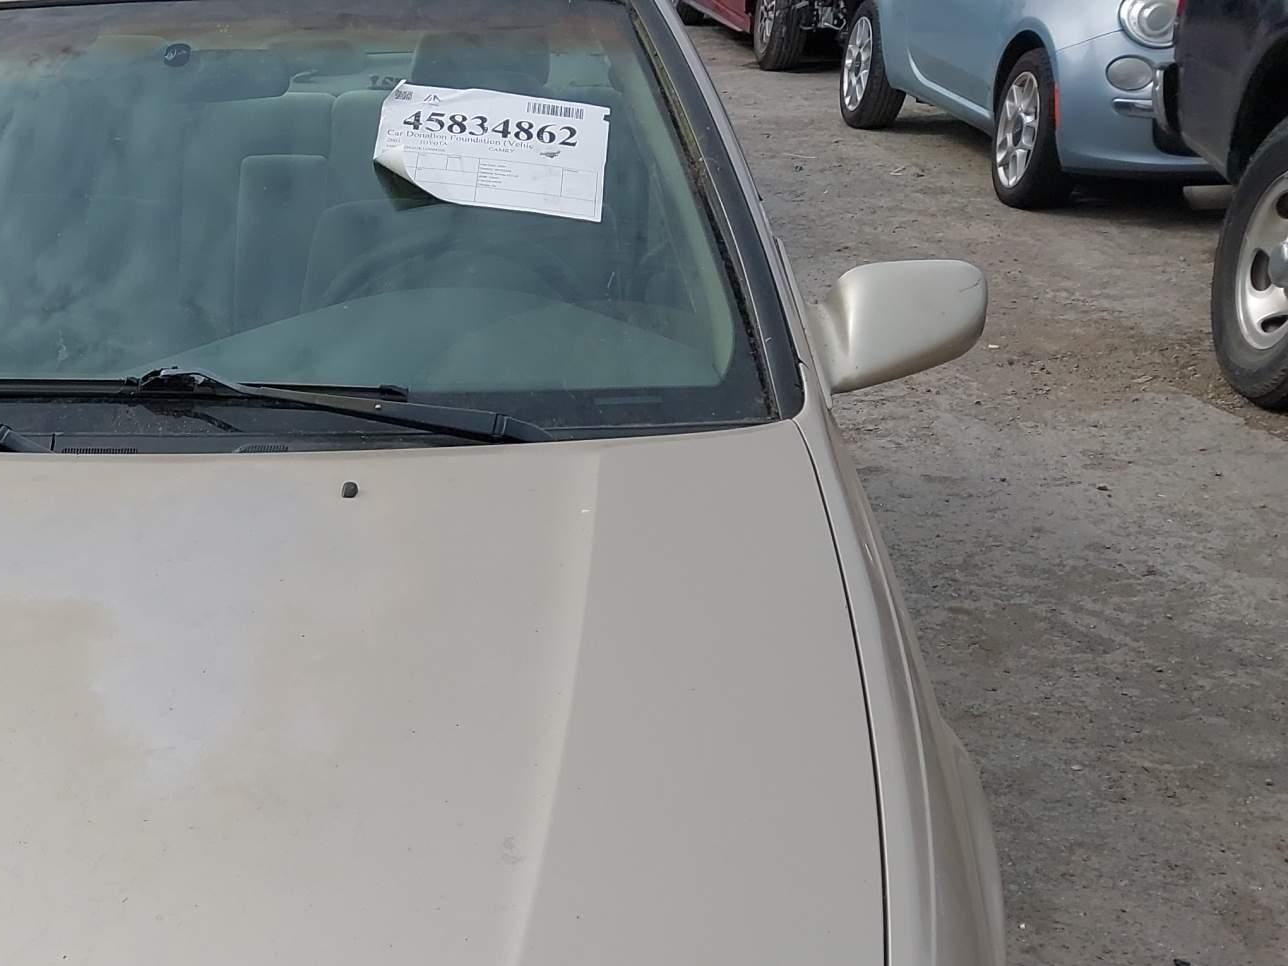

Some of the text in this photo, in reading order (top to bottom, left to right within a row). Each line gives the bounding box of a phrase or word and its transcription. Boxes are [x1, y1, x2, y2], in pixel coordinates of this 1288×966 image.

[387, 129, 404, 138] Car
[406, 130, 447, 141] Donation
[450, 134, 502, 146] Foundation
[402, 109, 579, 148] 45834862
